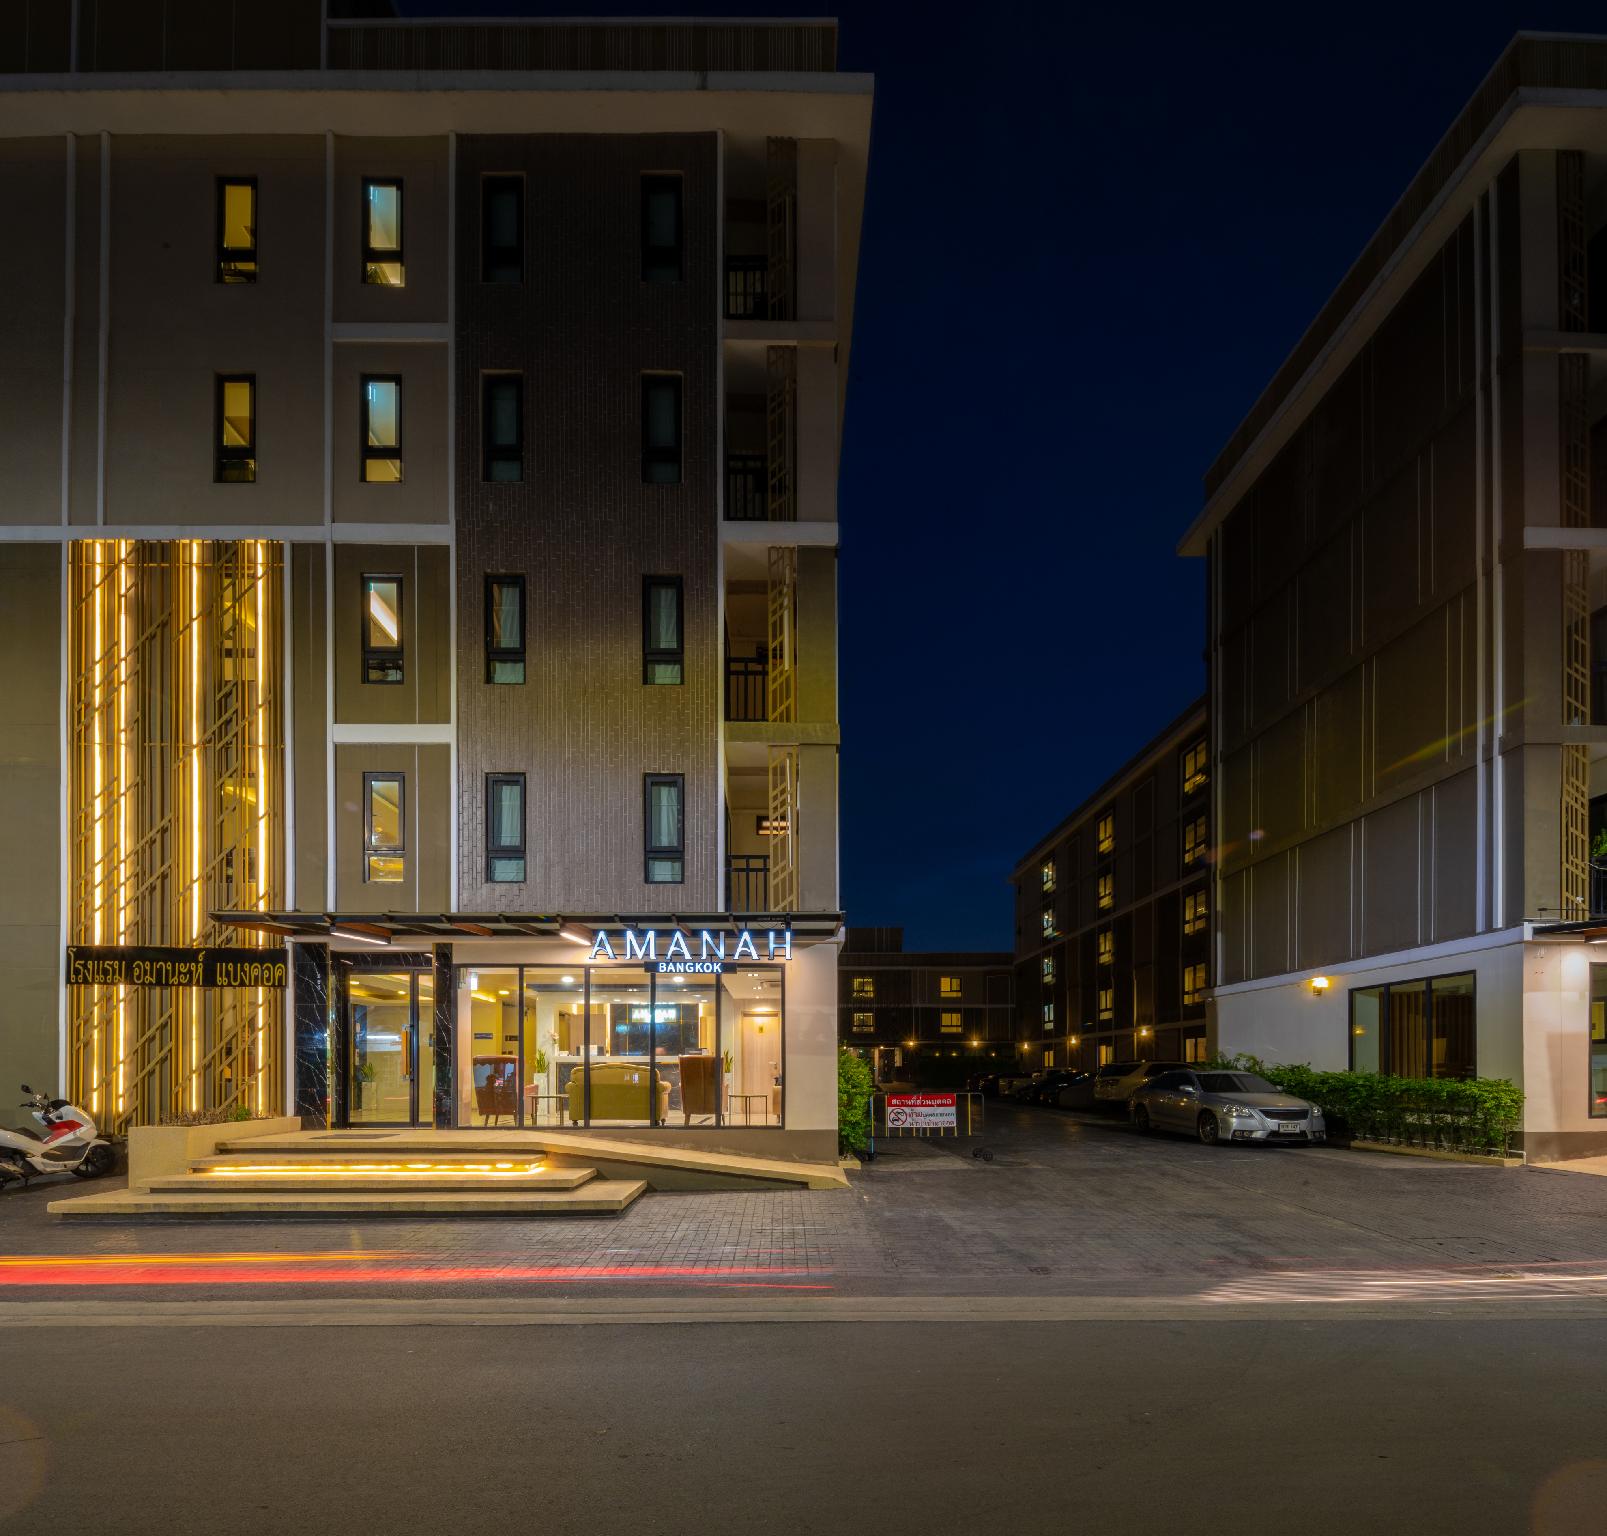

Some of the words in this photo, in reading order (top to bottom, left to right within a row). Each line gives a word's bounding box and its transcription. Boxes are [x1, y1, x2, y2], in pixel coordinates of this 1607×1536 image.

[589, 930, 792, 960] AMANAH
[67, 948, 126, 983] โรงแรม
[132, 950, 206, 986] อมานะห์
[216, 962, 286, 986] แบงคอค
[658, 962, 722, 973] BANGKOK
